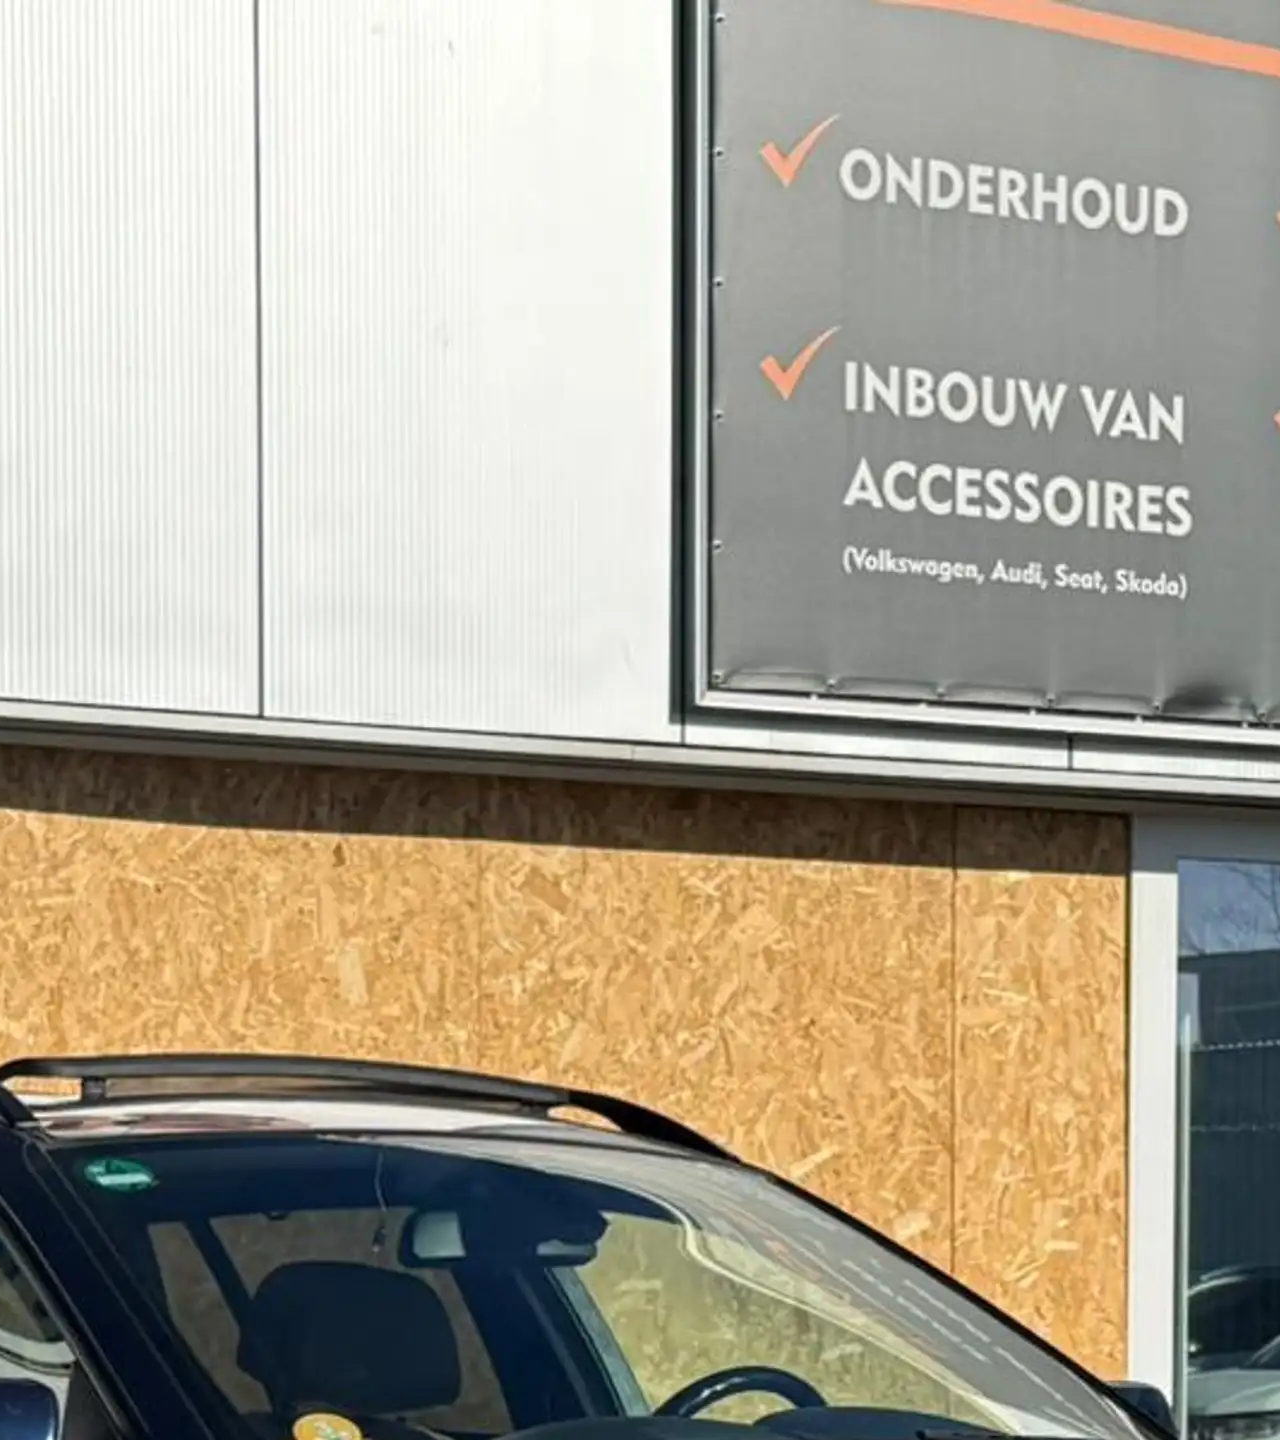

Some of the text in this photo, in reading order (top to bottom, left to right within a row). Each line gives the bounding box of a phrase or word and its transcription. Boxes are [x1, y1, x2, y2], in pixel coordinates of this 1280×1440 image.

[838, 147, 1189, 237] ONDERHOUD
[845, 360, 1184, 445] INBOUW VAN
[842, 457, 1193, 537] ACCESSOIRES
[842, 545, 1188, 600] (Volkswagen, Audi, Seat, Skoda)
